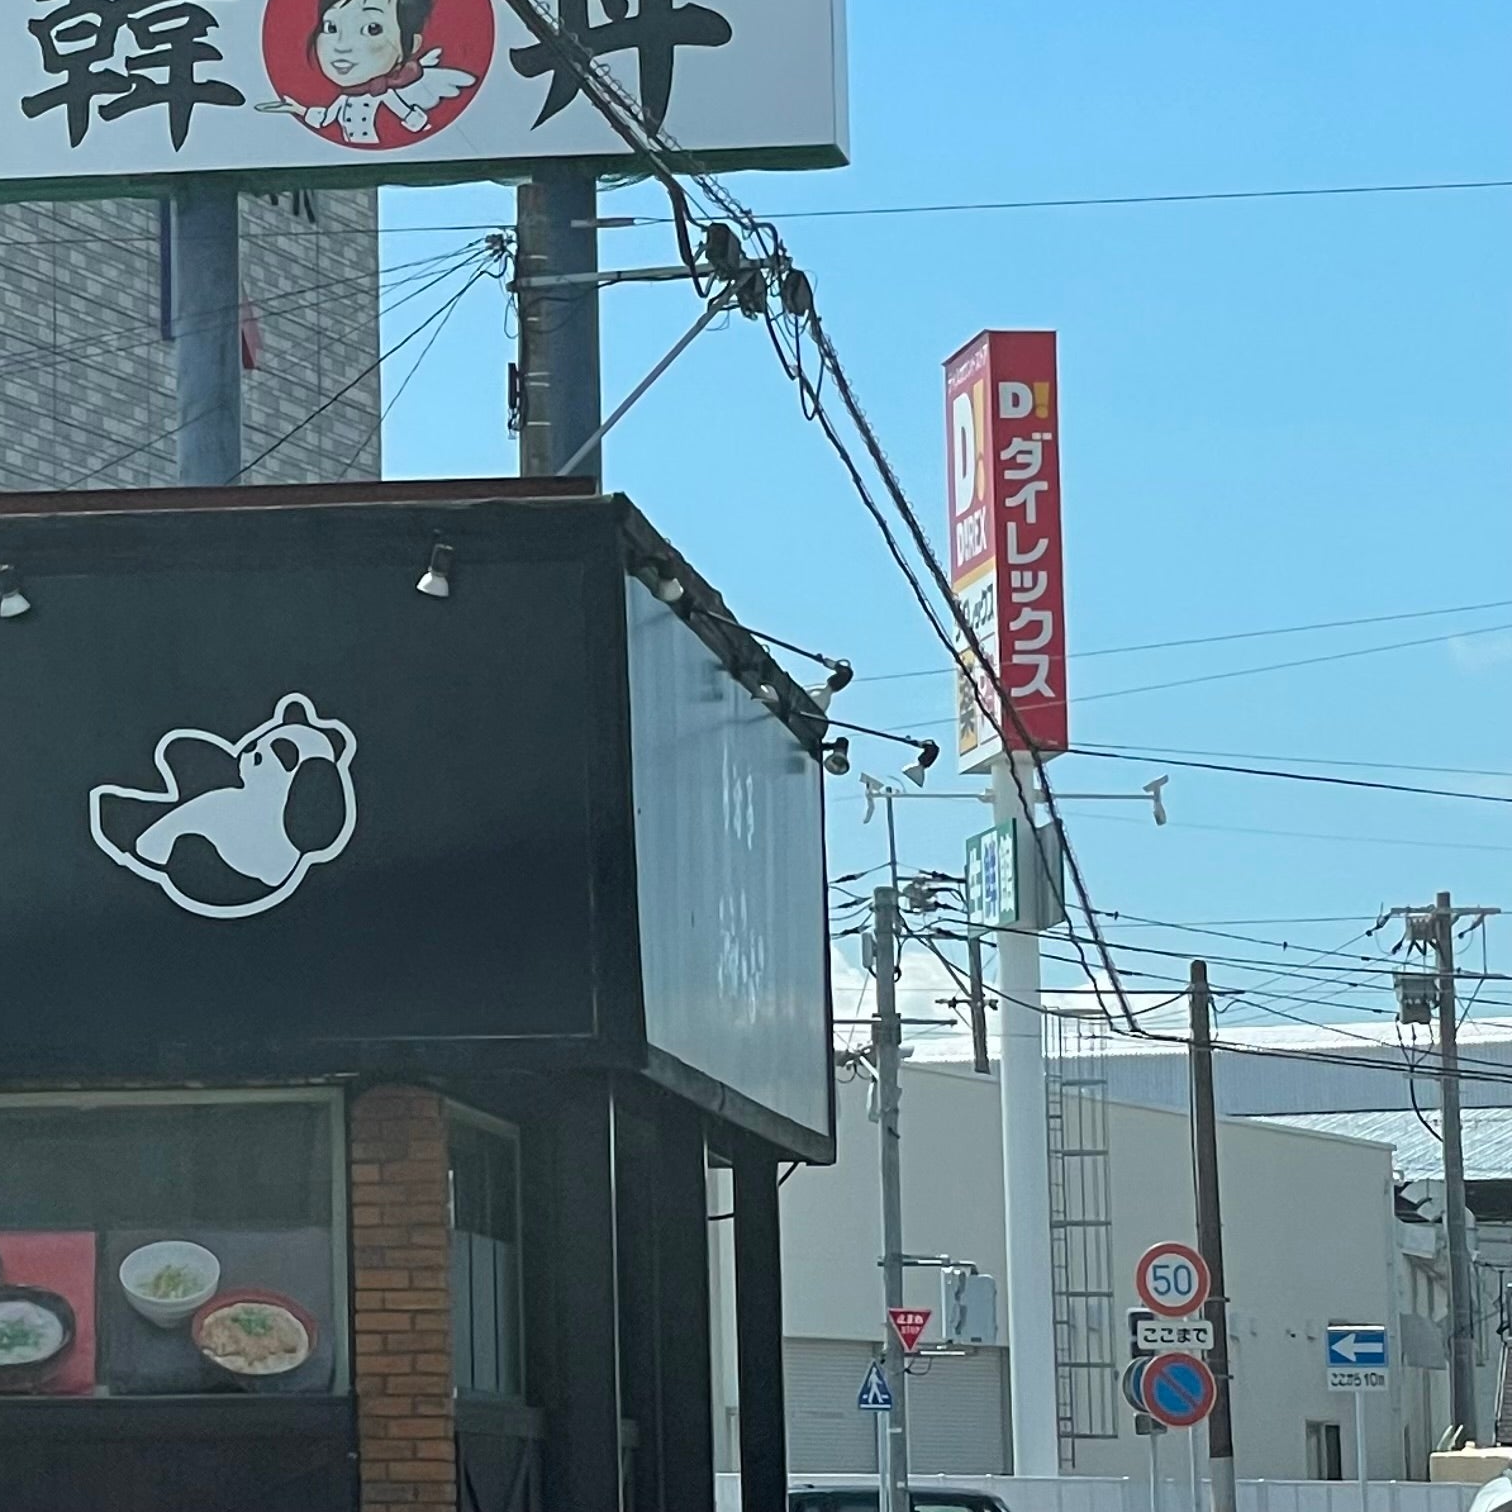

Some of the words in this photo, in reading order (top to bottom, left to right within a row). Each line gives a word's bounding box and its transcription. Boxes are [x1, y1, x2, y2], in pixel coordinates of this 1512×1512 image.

[999, 432, 1055, 698] ダイレックス
[1152, 1264, 1193, 1296] 50
[1143, 1327, 1208, 1343] ここまで
